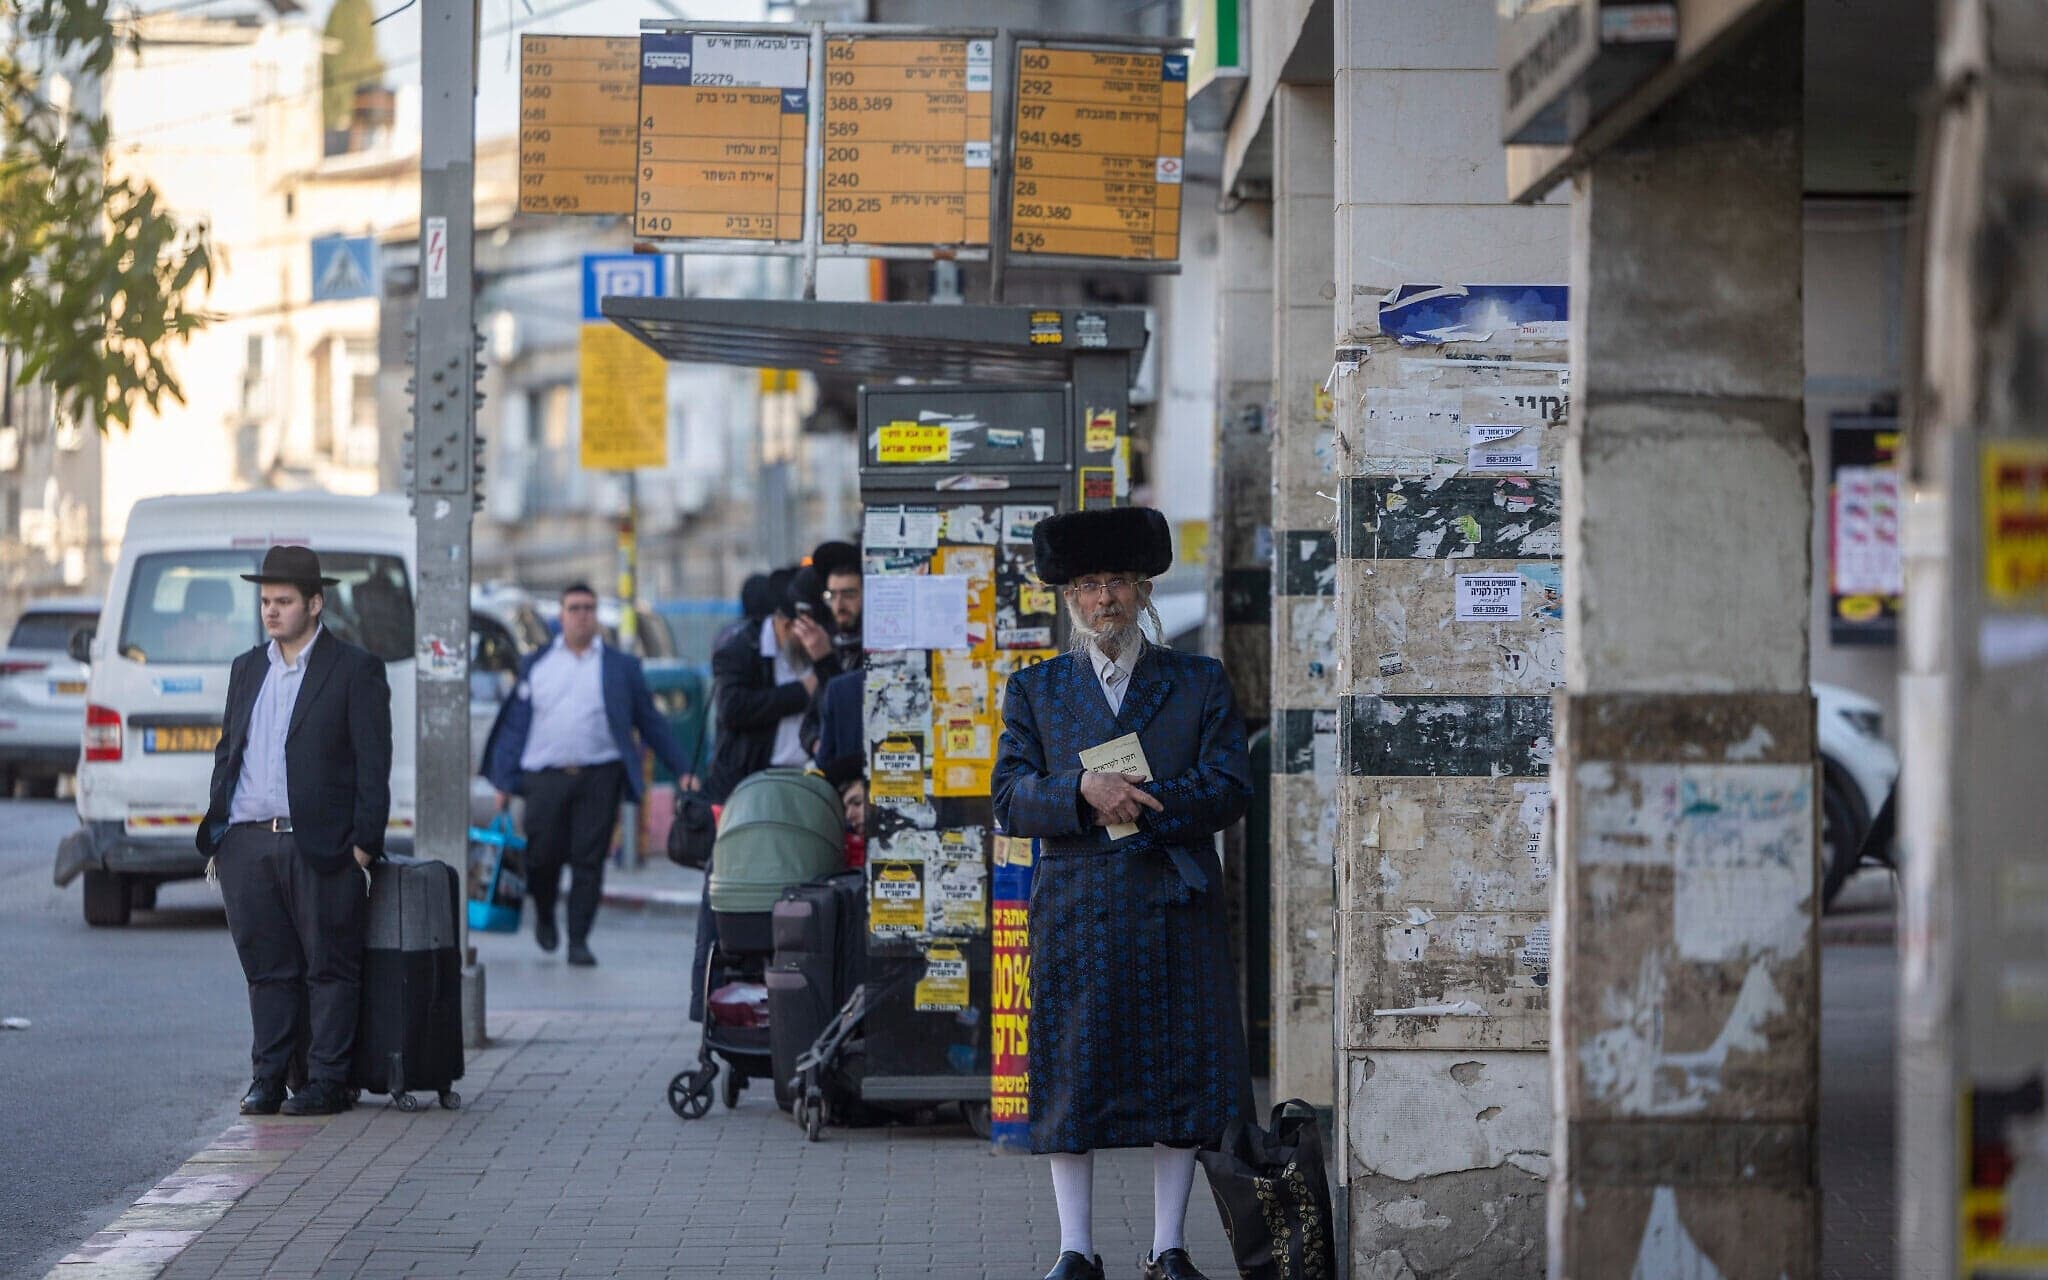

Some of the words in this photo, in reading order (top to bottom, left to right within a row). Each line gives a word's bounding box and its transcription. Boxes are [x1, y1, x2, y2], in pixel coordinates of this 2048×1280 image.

[829, 46, 855, 61] 146
[1023, 54, 1049, 69] 160
[693, 73, 734, 85] 22279
[829, 72, 855, 86] 190
[1022, 80, 1052, 95] 292
[696, 92, 718, 103] ברק
[722, 92, 737, 103] בני
[829, 96, 893, 114] 388,389
[1021, 105, 1046, 120] 917
[644, 116, 654, 128] 4
[828, 122, 859, 136] 589
[1020, 131, 1082, 148] 941,945
[642, 141, 653, 155] 5
[726, 143, 755, 155] עלמין
[758, 144, 778, 155] בית
[827, 147, 859, 162] 200
[1018, 156, 1033, 170] 18
[643, 168, 653, 181] 9
[702, 170, 736, 181] השחר
[740, 170, 774, 181] איילת
[827, 172, 859, 187] 240
[1016, 182, 1037, 196] 28
[641, 192, 651, 205] 9
[827, 198, 881, 214] 210,215
[1017, 204, 1072, 221] 280,380
[640, 216, 672, 231] 140
[726, 217, 750, 228] ברק
[756, 218, 773, 228] בני
[827, 223, 858, 237] 220
[1014, 231, 1045, 247] 436
[1471, 586, 1492, 597] לקניה
[1493, 587, 1510, 596] דירה
[991, 953, 1032, 1010] 00%
[991, 1013, 1029, 1065] צדק
[991, 1071, 1030, 1093] למשפ
